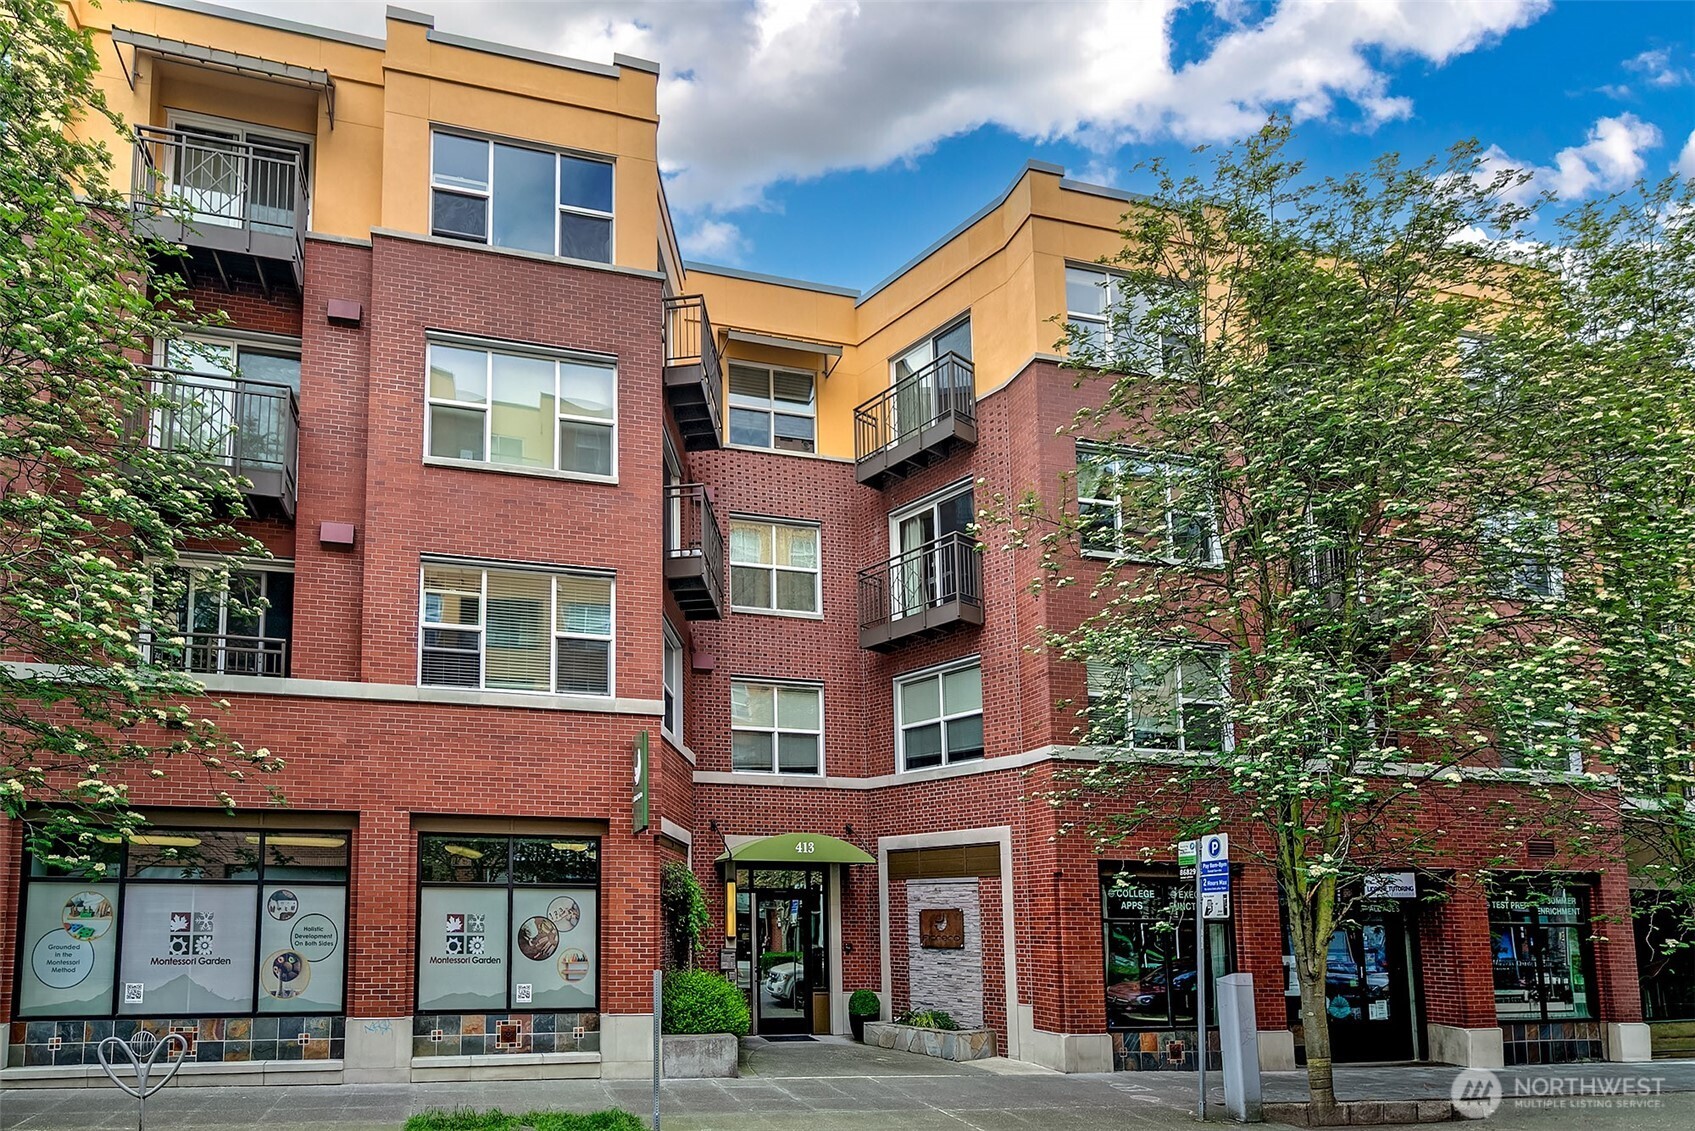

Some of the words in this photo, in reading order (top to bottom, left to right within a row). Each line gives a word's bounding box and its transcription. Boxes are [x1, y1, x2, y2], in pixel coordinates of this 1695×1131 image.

[795, 841, 815, 854] 413
[1211, 841, 1219, 854] P
[1179, 868, 1196, 876] 86829
[1202, 878, 1207, 887] 2
[1116, 889, 1155, 898] COLLEGE
[1121, 901, 1143, 910] APPS
[1491, 900, 1509, 909] TEST
[1538, 907, 1580, 915] ENRICHMENT
[150, 956, 197, 966] Montessori
[198, 956, 231, 966] Garden
[429, 956, 471, 965] Montessori
[471, 956, 502, 965] Garden
